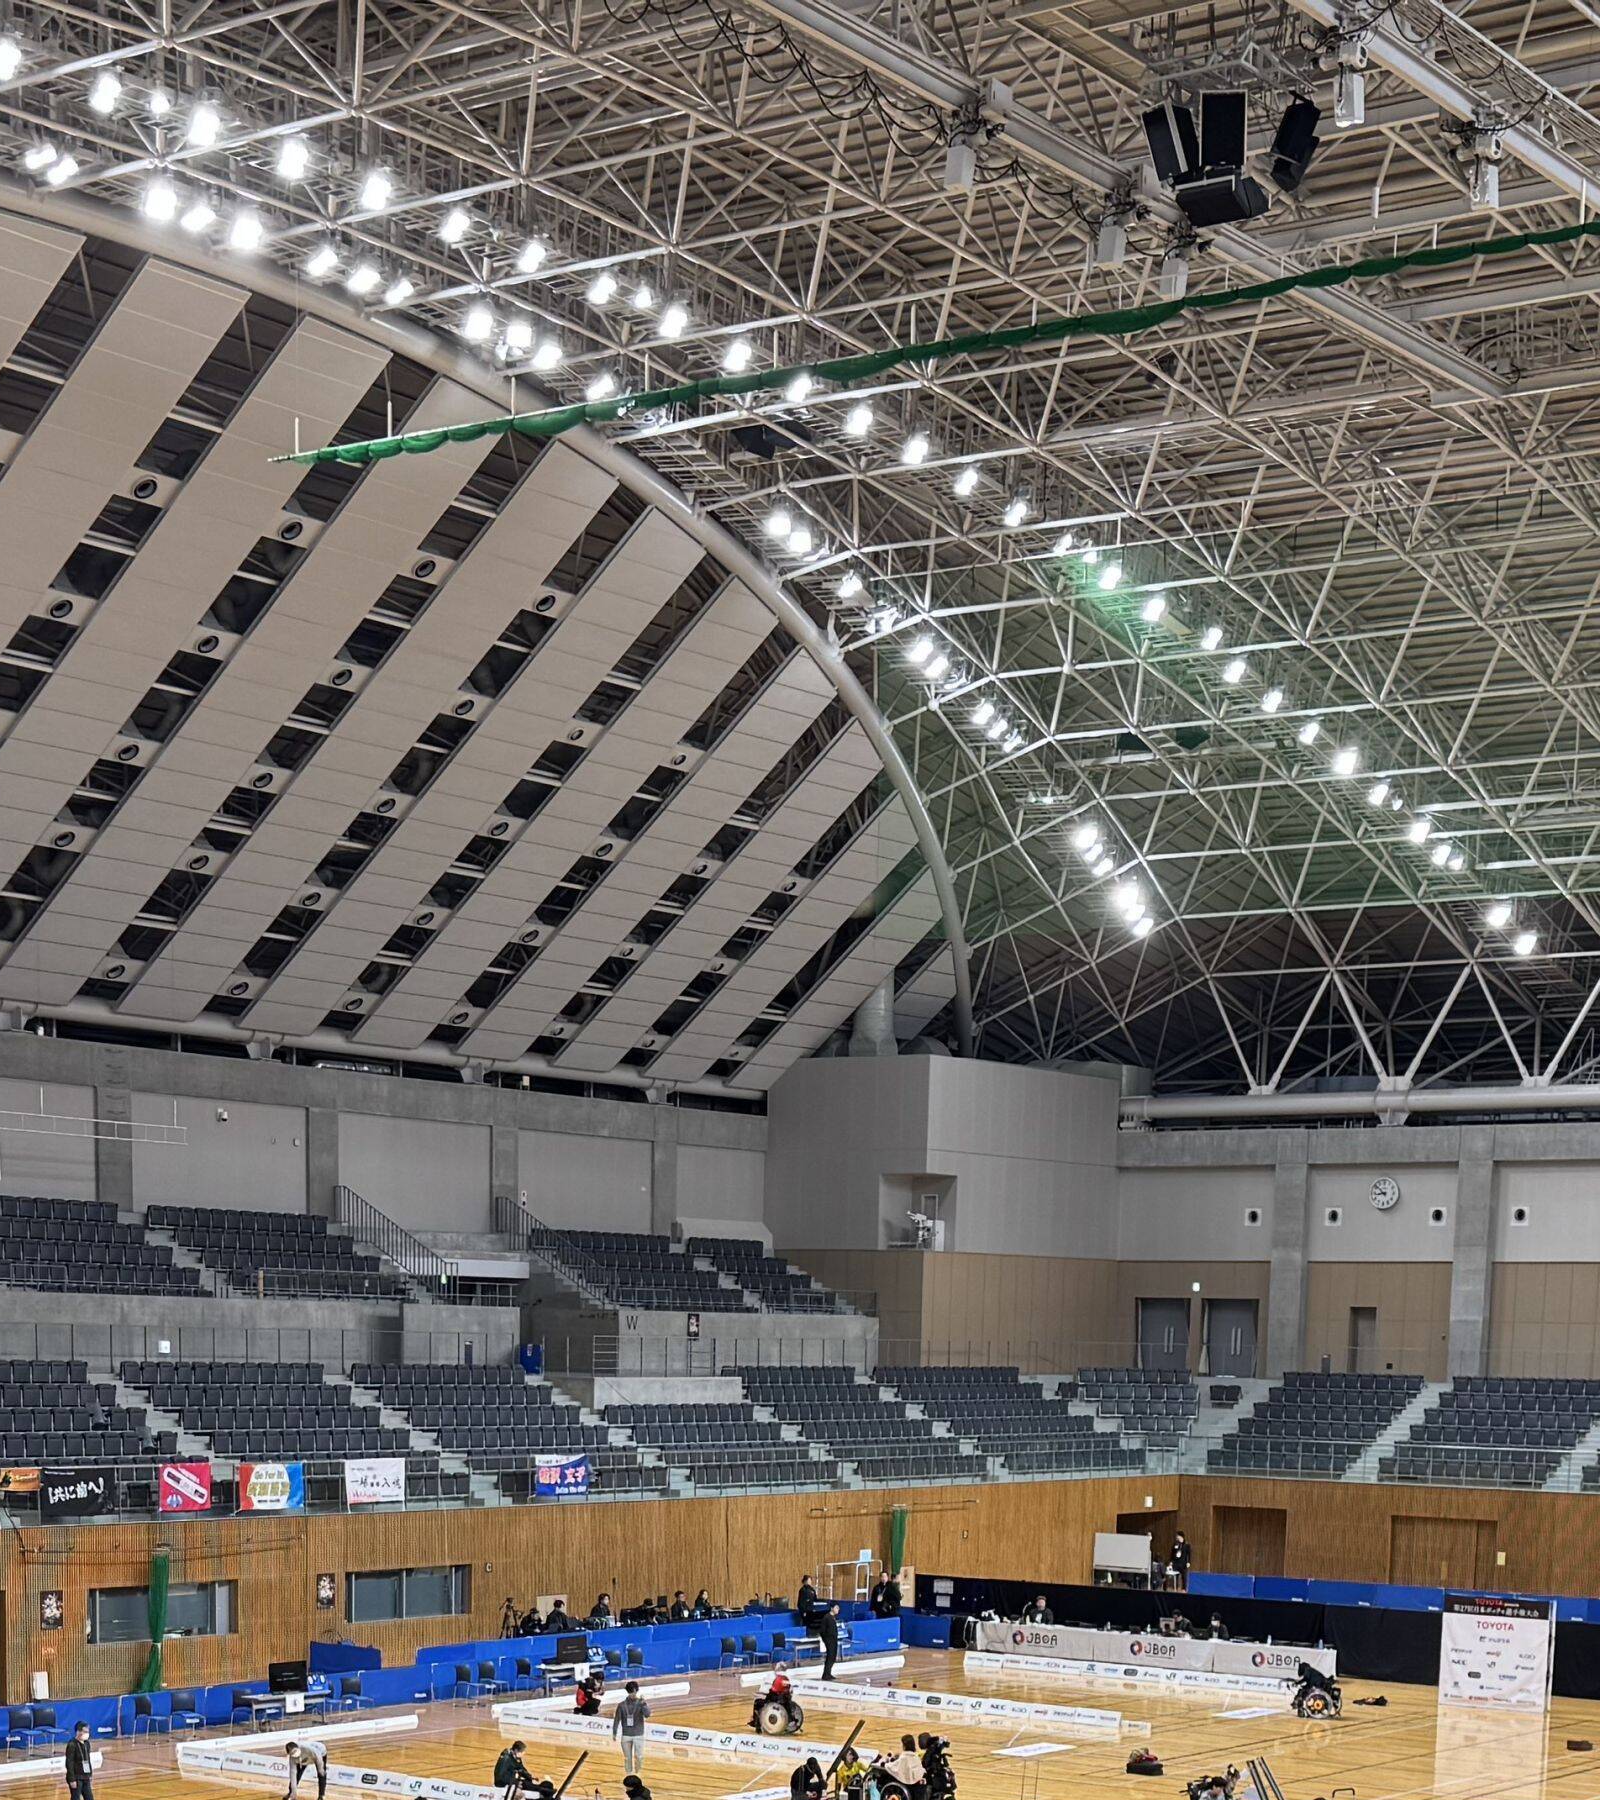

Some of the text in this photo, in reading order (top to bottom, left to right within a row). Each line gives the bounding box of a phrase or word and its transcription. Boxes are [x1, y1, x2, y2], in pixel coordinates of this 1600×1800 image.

[1477, 1621, 1515, 1632] TOYOTA
[1025, 1632, 1059, 1647] JBOA
[1144, 1642, 1176, 1657] JBOA
[1266, 1652, 1301, 1667] JBOA
